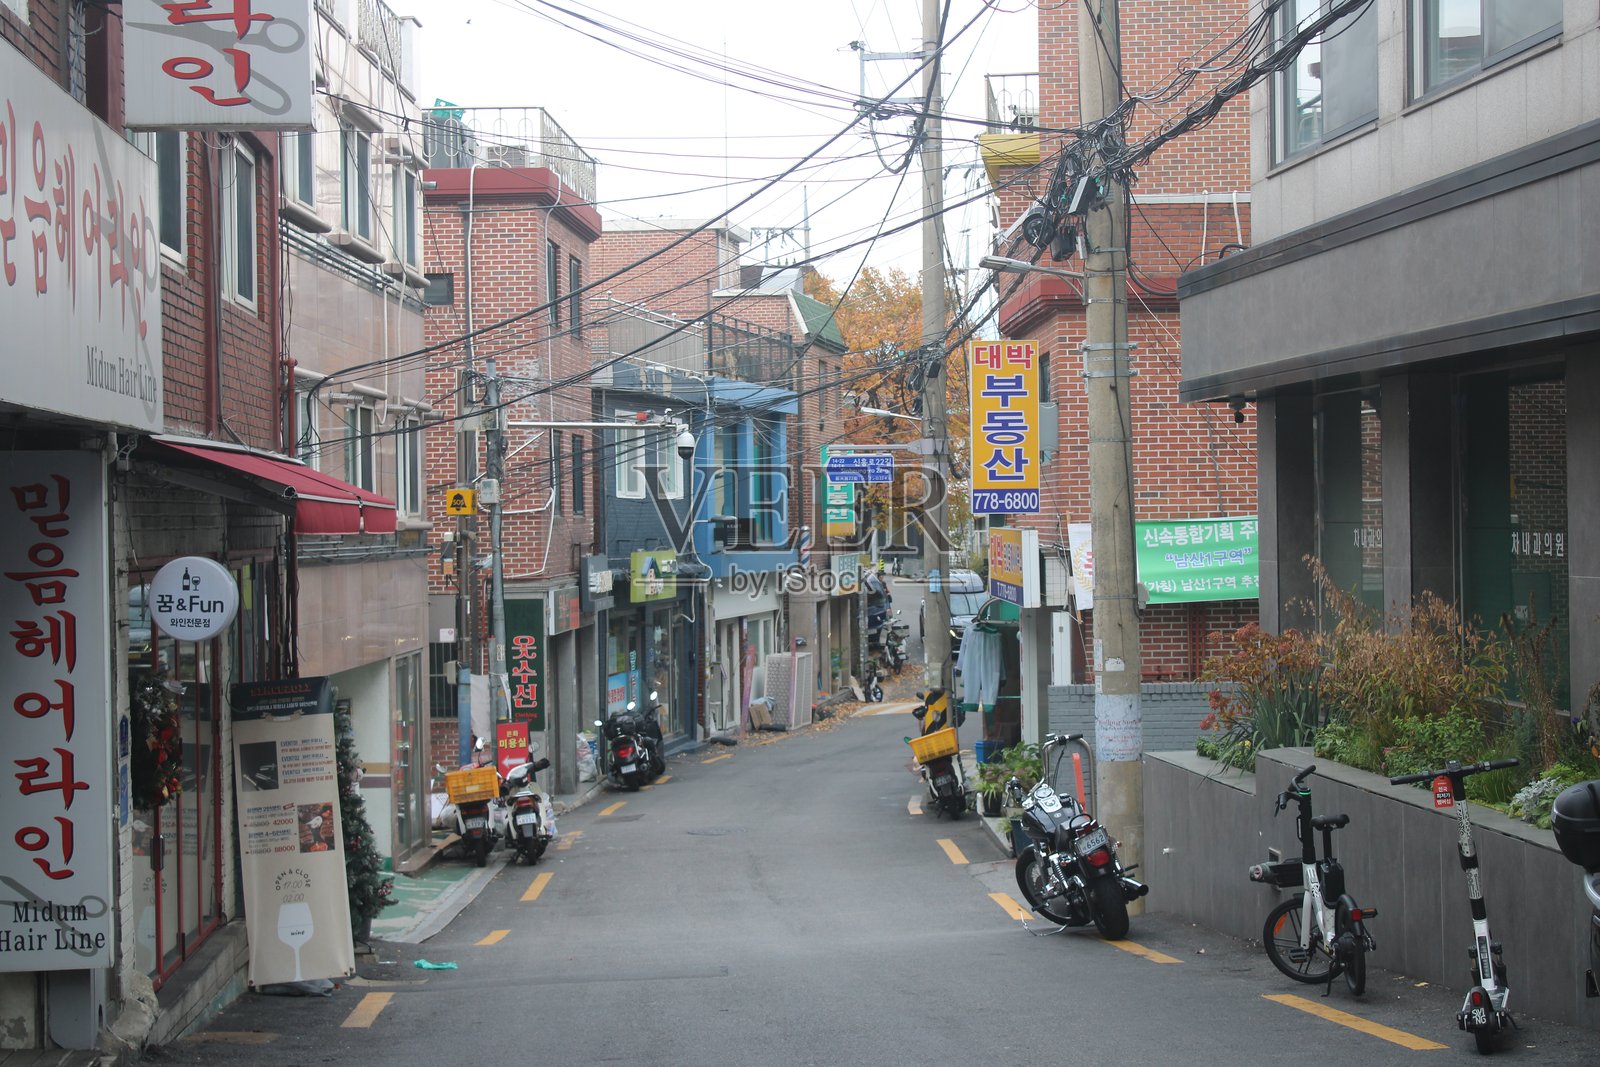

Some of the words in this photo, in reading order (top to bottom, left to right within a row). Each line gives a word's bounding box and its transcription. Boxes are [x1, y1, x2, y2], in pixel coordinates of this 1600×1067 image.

[974, 344, 1035, 370] 대박
[86, 345, 117, 393] Midum
[118, 356, 137, 399] Hair
[139, 364, 157, 404] Line
[980, 374, 1030, 482] 부동산
[973, 492, 1038, 510] 778-6800
[1143, 522, 1235, 548] 신속통합기획
[1240, 520, 1258, 540] 주
[1511, 531, 1564, 557] 차내과의원
[1181, 576, 1237, 592] 남산1구역
[170, 618, 211, 628] 와인전문점
[4, 473, 91, 881] 믿음헤어라인
[511, 635, 538, 708] 옷수선
[499, 737, 527, 749] 미용실
[1087, 834, 1105, 849] 6562
[13, 900, 88, 923] Midum
[0, 928, 47, 952] Hair
[54, 927, 106, 950] Line
